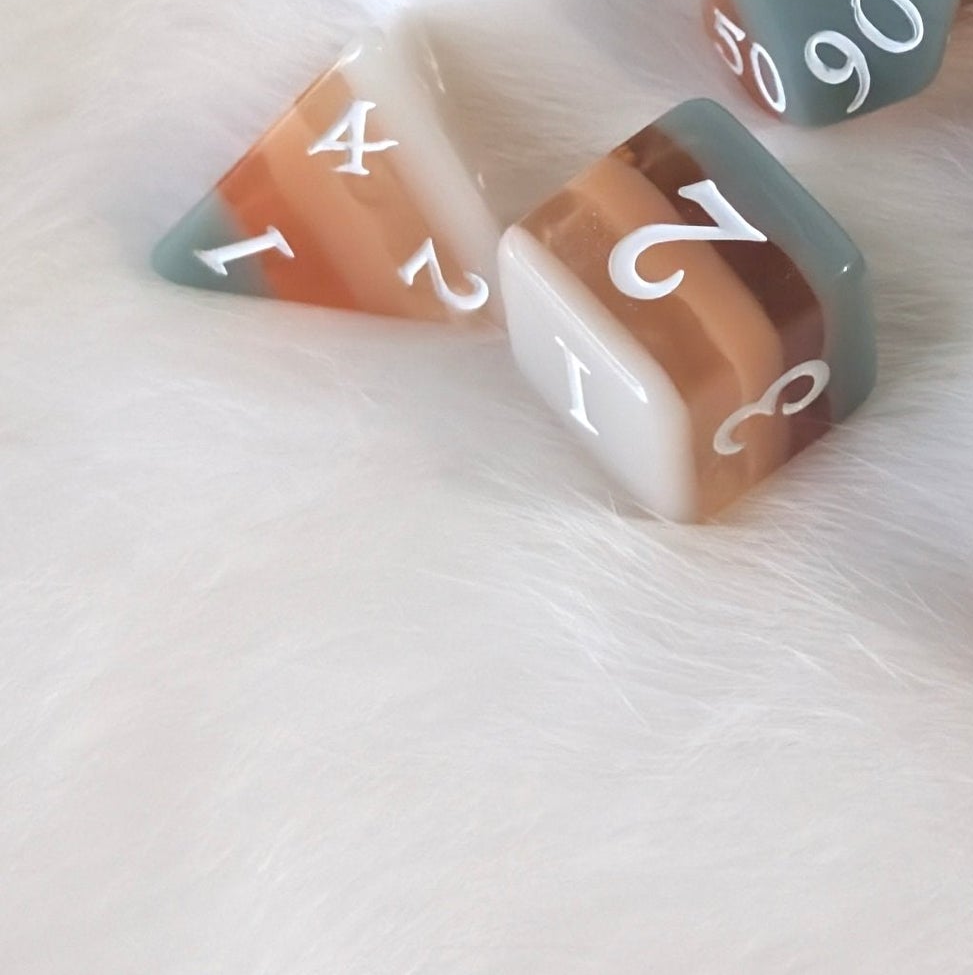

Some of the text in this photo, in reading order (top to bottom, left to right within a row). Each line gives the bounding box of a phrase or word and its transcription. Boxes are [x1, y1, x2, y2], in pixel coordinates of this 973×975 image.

[714, 7, 787, 113] 50
[307, 99, 399, 176] 4
[193, 225, 295, 277] 1
[399, 237, 490, 312] 2
[608, 179, 768, 301] 2
[554, 334, 600, 436] 1
[712, 359, 832, 456] 3
